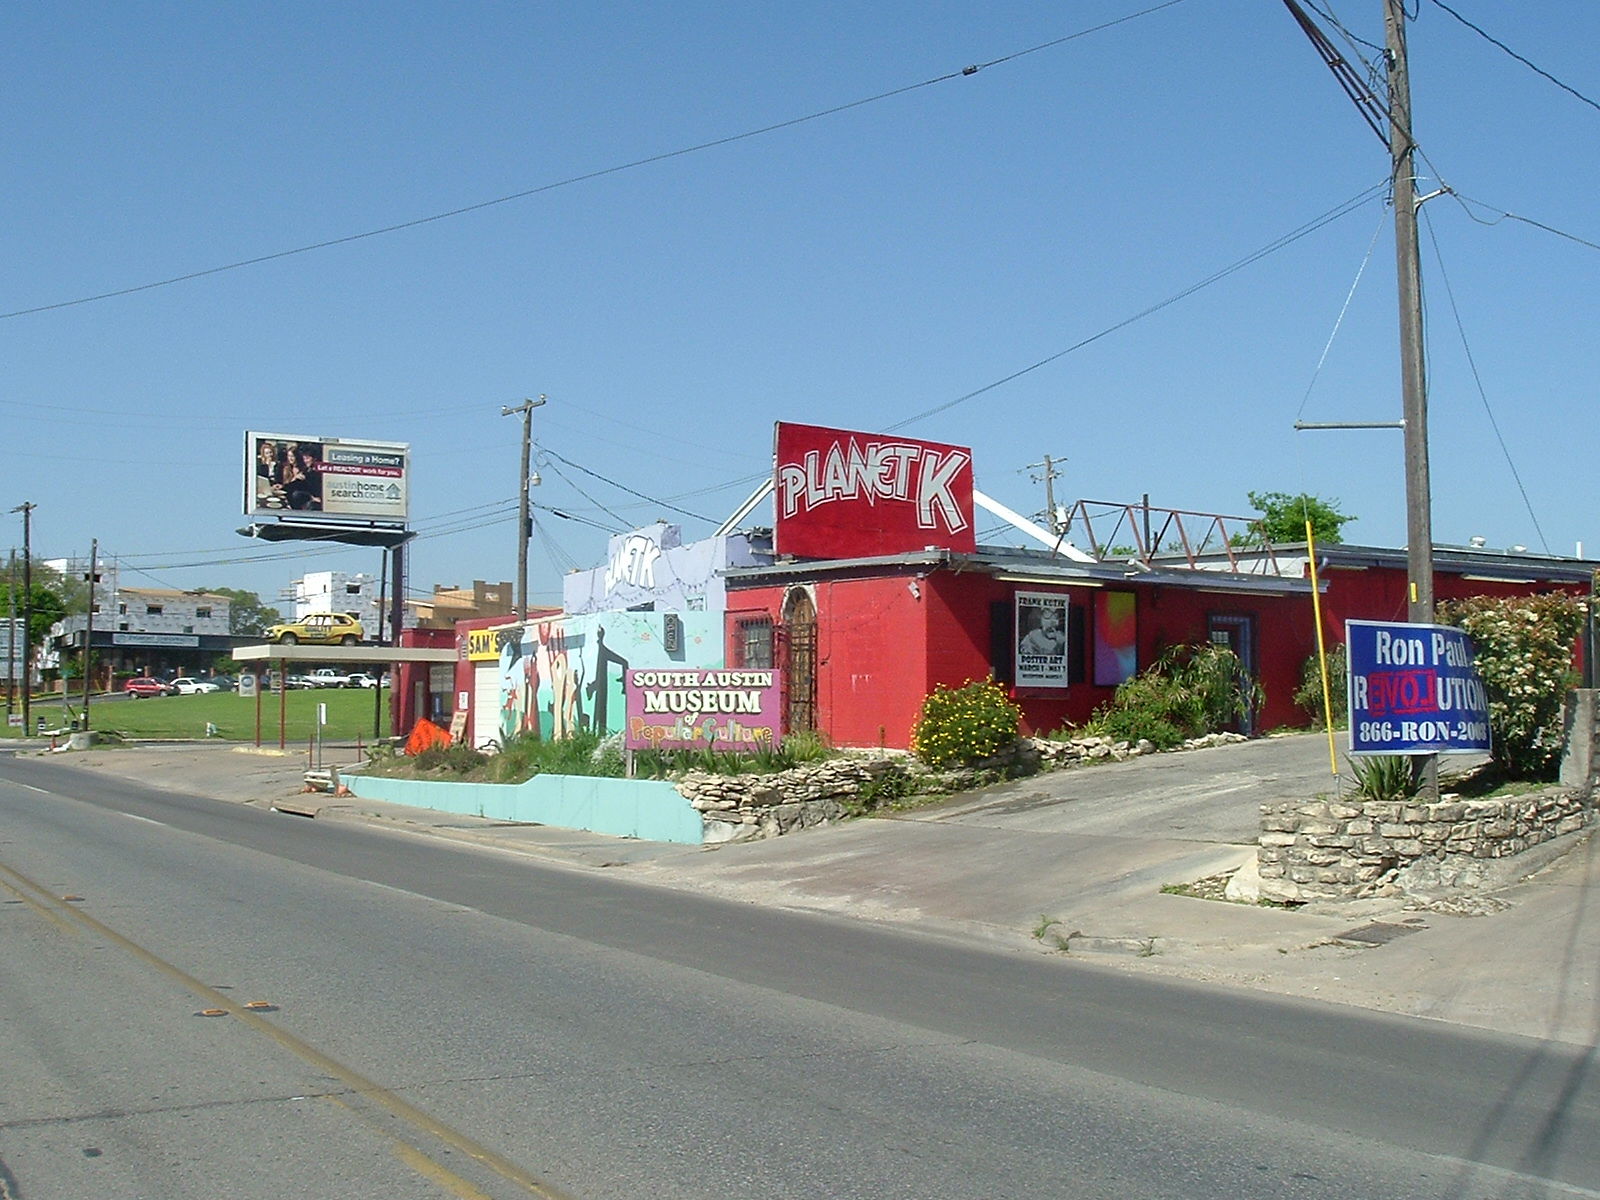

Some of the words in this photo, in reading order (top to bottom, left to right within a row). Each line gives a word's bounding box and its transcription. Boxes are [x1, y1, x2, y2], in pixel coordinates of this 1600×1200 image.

[331, 453, 364, 463] Leasing
[372, 456, 400, 465] Home?
[780, 436, 921, 520] PLANET
[916, 449, 970, 535] K
[469, 633, 500, 655] SAM'S
[1376, 631, 1424, 666] Ron
[1431, 633, 1468, 667] Paul
[633, 671, 700, 687] SOUTH
[702, 671, 773, 687] AUSTIN
[644, 690, 762, 714] MUSEUM
[684, 712, 700, 726] of
[630, 716, 704, 748] Popular
[702, 717, 774, 744] Culture
[1359, 721, 1488, 742] 866-RON-2008
